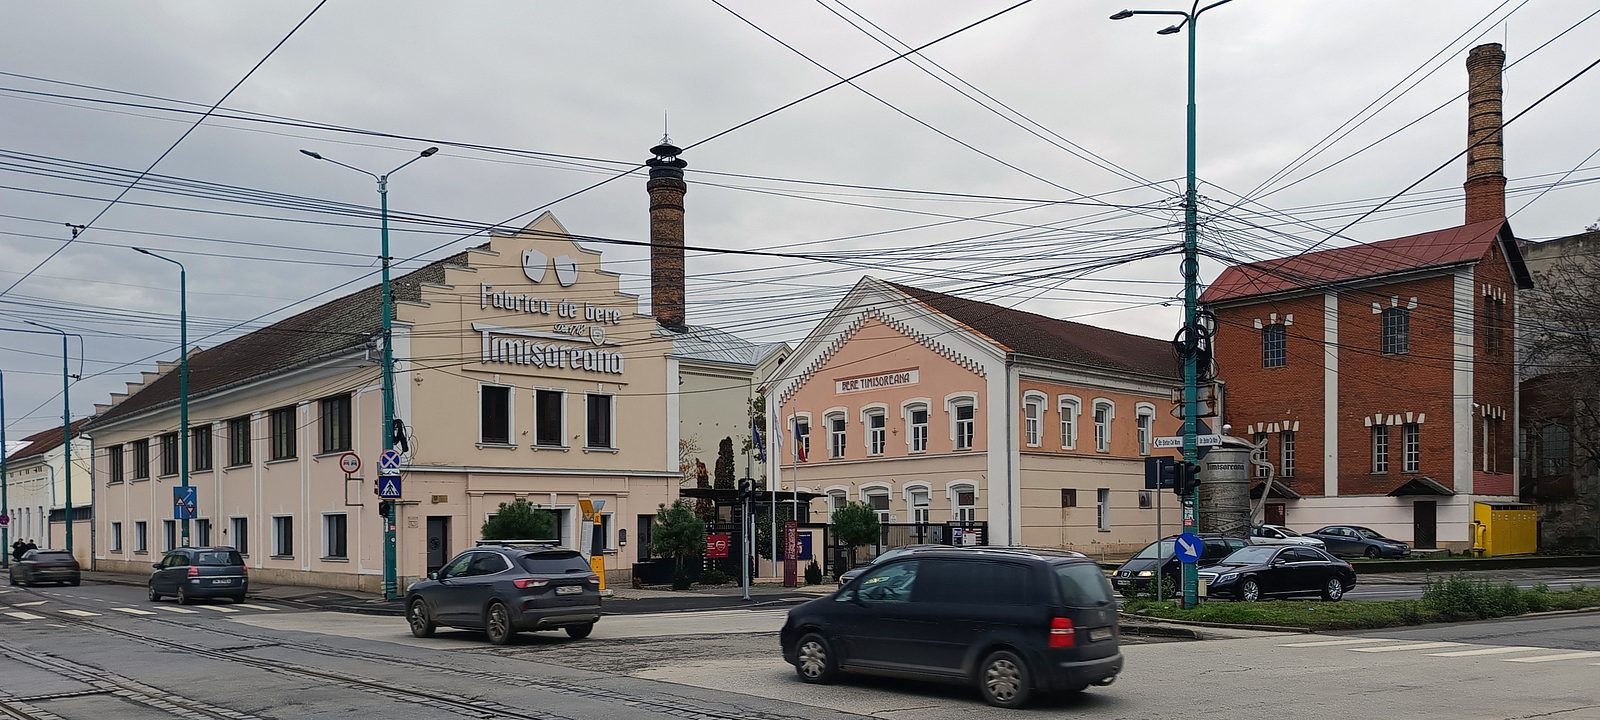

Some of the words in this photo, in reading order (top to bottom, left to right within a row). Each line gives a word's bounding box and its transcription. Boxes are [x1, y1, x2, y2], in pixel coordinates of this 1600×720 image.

[480, 282, 551, 315] Fabrica
[558, 299, 577, 318] de
[584, 302, 622, 324] bere
[841, 380, 859, 391] BERE
